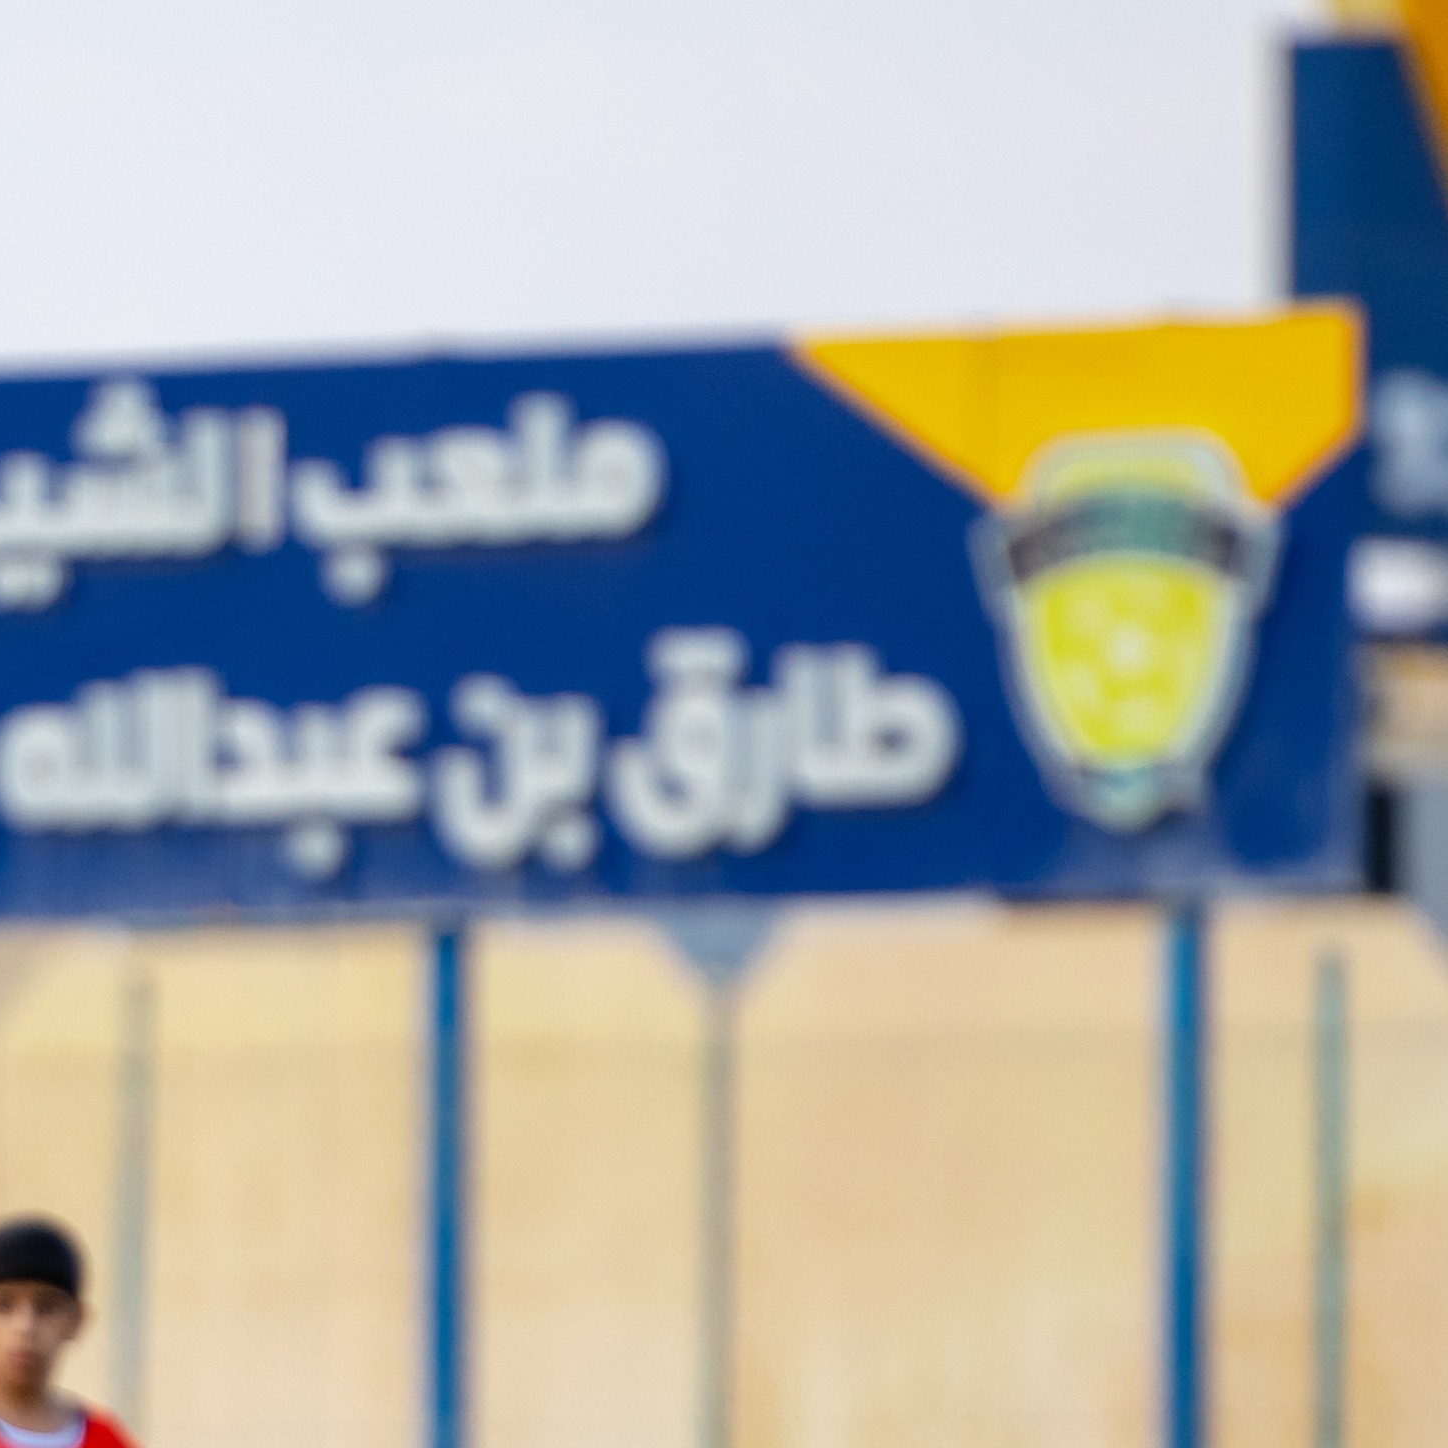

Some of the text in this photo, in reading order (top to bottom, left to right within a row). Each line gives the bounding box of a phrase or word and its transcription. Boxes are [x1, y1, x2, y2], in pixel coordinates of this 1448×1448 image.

[292, 391, 665, 606] ملعب
[429, 672, 604, 872] بن
[609, 624, 963, 862] طارق
